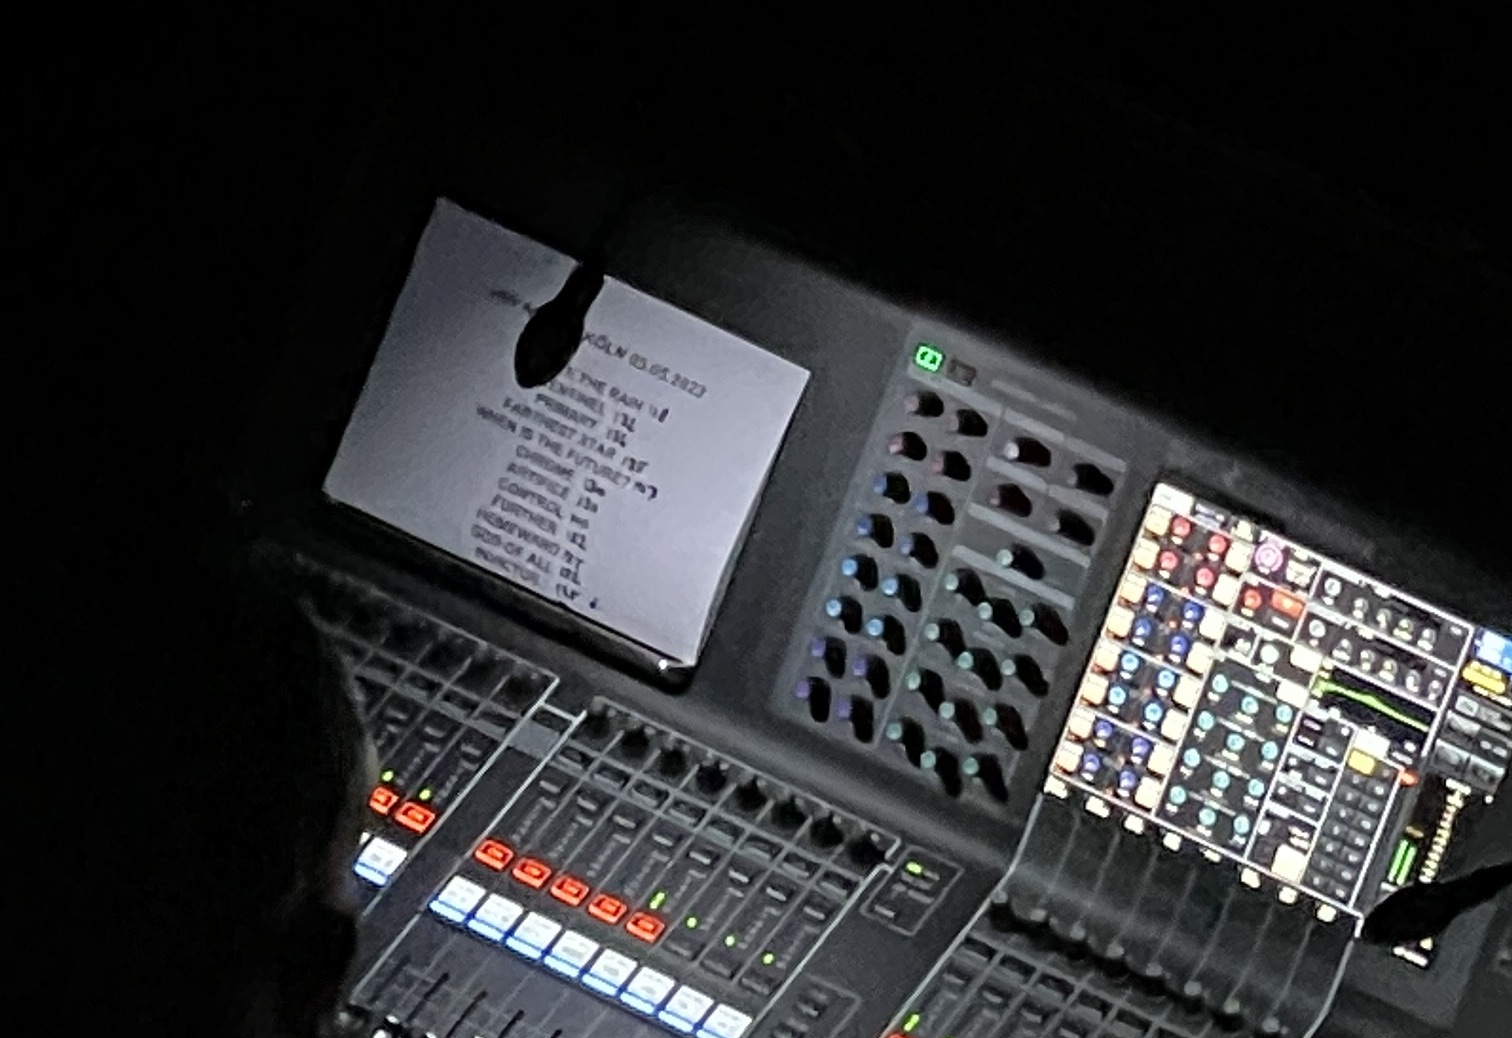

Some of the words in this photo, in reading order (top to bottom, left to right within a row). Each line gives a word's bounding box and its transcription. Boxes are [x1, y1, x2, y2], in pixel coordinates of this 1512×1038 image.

[583, 331, 629, 359] KÖLN
[629, 353, 707, 399] 05.05.2023
[533, 393, 601, 430] PRIMARY
[548, 381, 605, 417] ENTINEL
[578, 371, 607, 396] THE
[608, 386, 645, 412] RAIN
[476, 404, 517, 433] WHEN
[518, 426, 535, 441] IS
[538, 432, 564, 457] THE
[566, 448, 634, 489] FUTURE?
[516, 445, 576, 484] CHROME
[490, 493, 559, 537] FURTHER
[497, 477, 564, 521] CONTROL
[471, 523, 504, 548] GOD
[502, 541, 524, 558] OF
[526, 551, 552, 575] ALL
